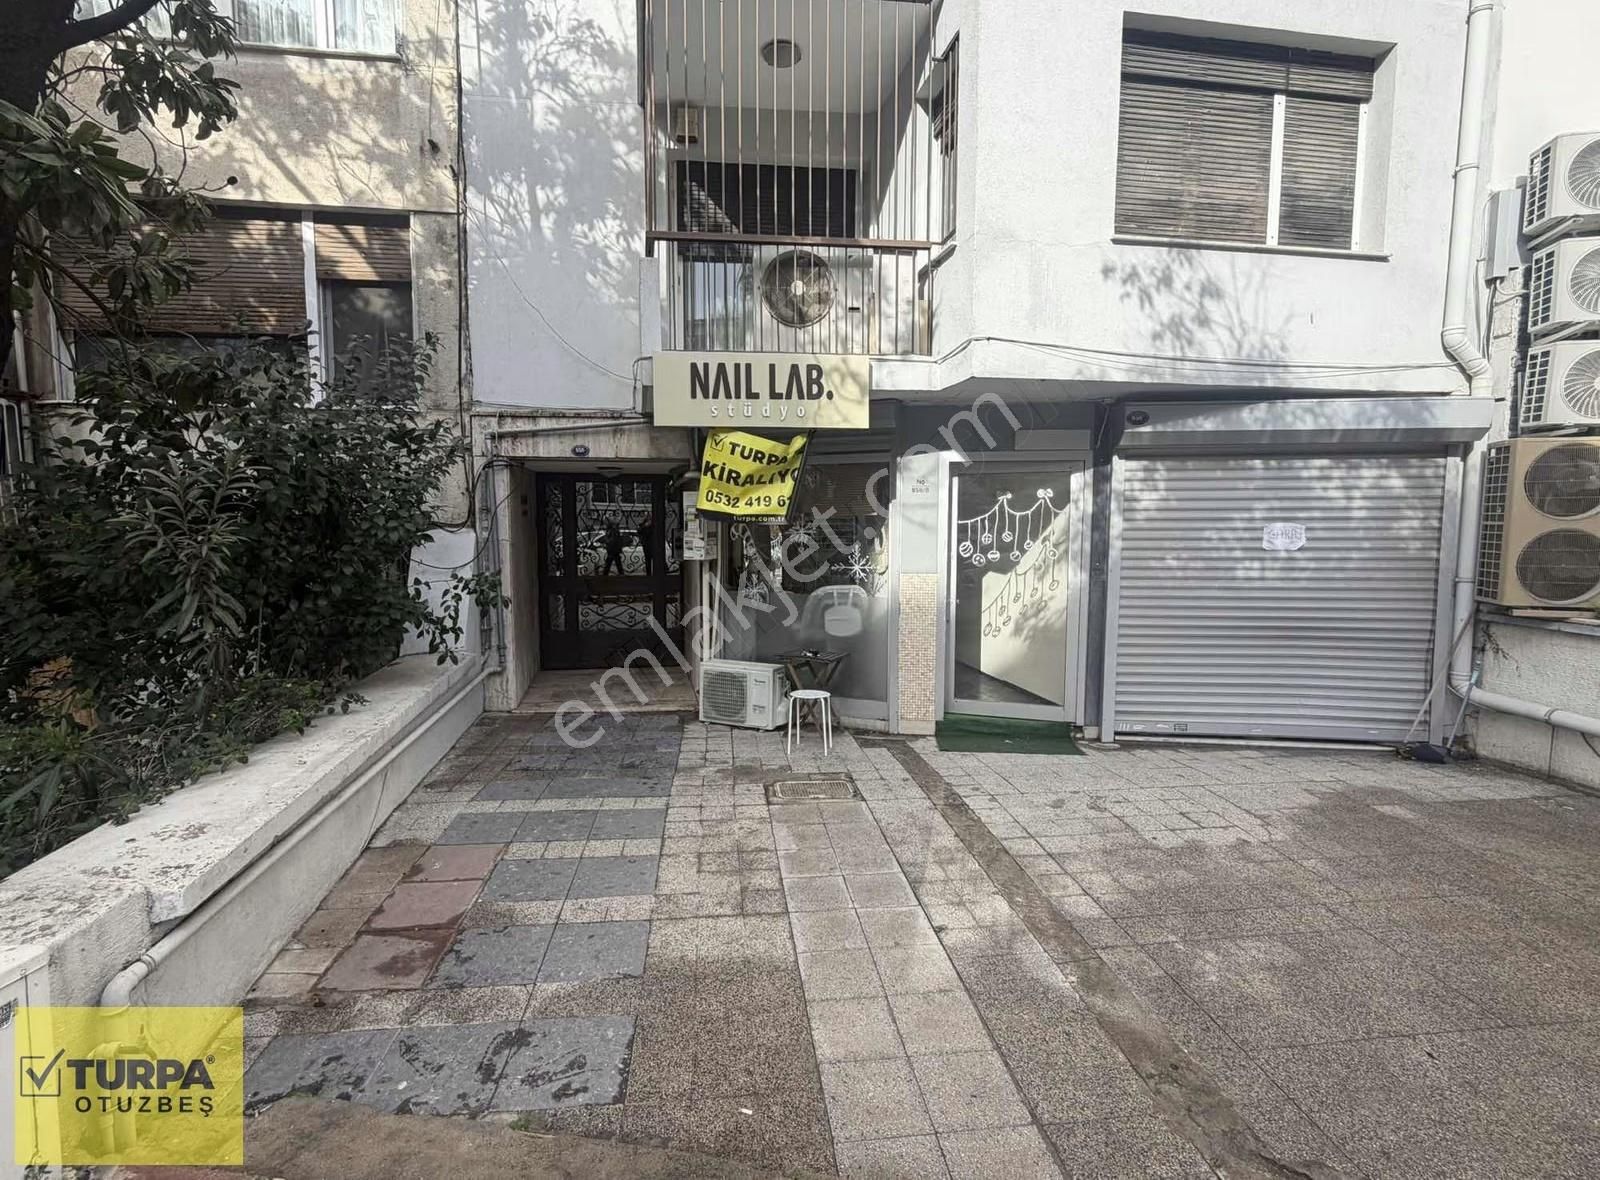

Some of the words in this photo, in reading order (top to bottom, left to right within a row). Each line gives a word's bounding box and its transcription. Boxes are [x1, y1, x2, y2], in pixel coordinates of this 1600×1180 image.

[690, 362, 760, 400] NAIL
[768, 363, 834, 401] LAB.
[711, 402, 806, 420] stüdyo
[705, 489, 740, 508] 0532
[744, 495, 772, 507] 419
